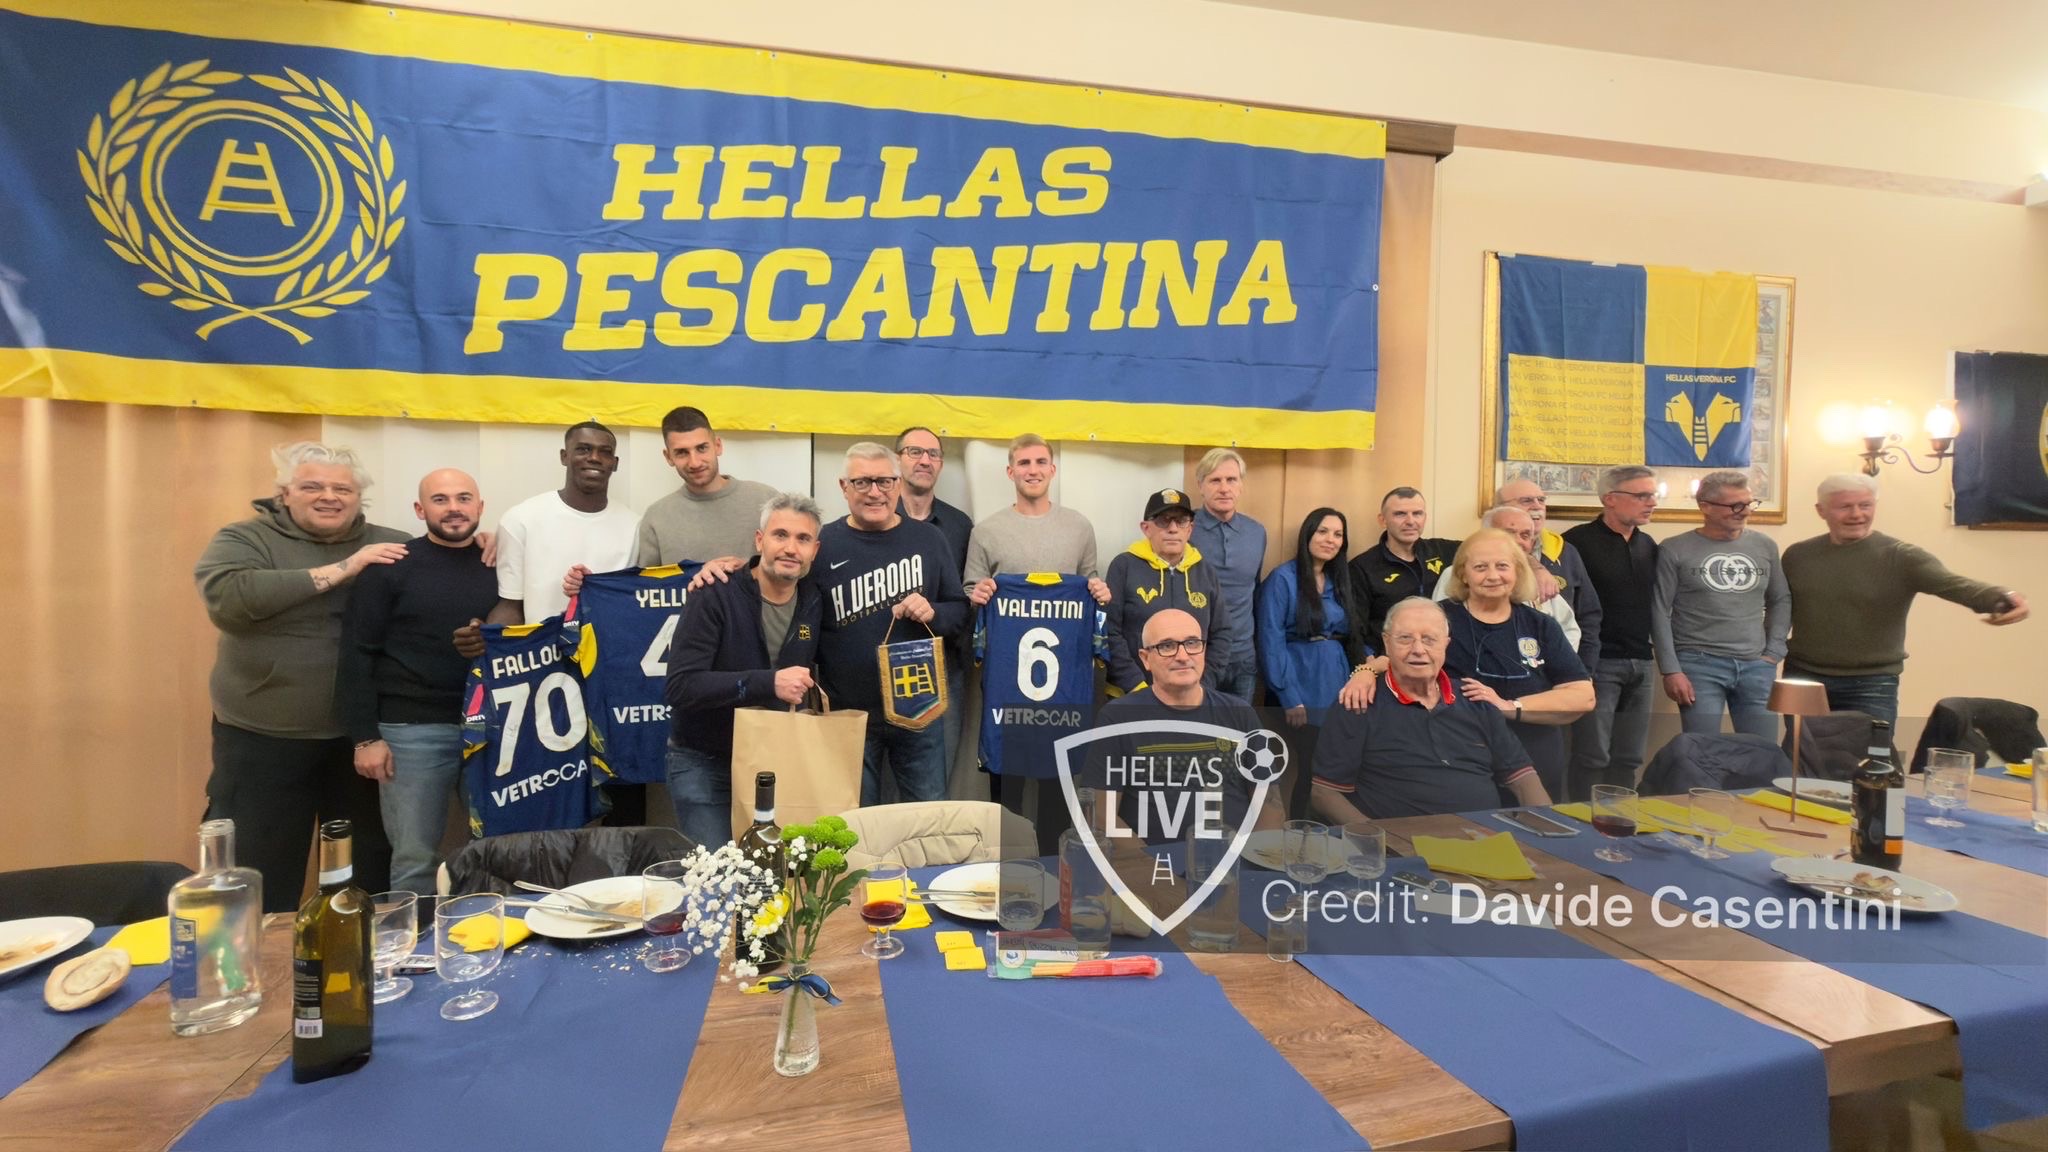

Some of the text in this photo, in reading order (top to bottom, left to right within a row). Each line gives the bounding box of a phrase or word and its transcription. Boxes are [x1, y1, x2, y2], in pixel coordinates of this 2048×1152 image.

[602, 144, 1112, 220] HELLAS
[463, 239, 1298, 355] PESCANTINA
[1665, 373, 1693, 382] HELLAS
[1694, 375, 1723, 384] VERONA
[997, 598, 1083, 619] VALENTINI
[492, 644, 562, 679] FALLOU
[640, 614, 680, 677] 4
[1017, 627, 1059, 702] 6
[491, 671, 588, 777] 70
[992, 708, 1081, 727] VETROCAR
[491, 760, 588, 807] VETROCA
